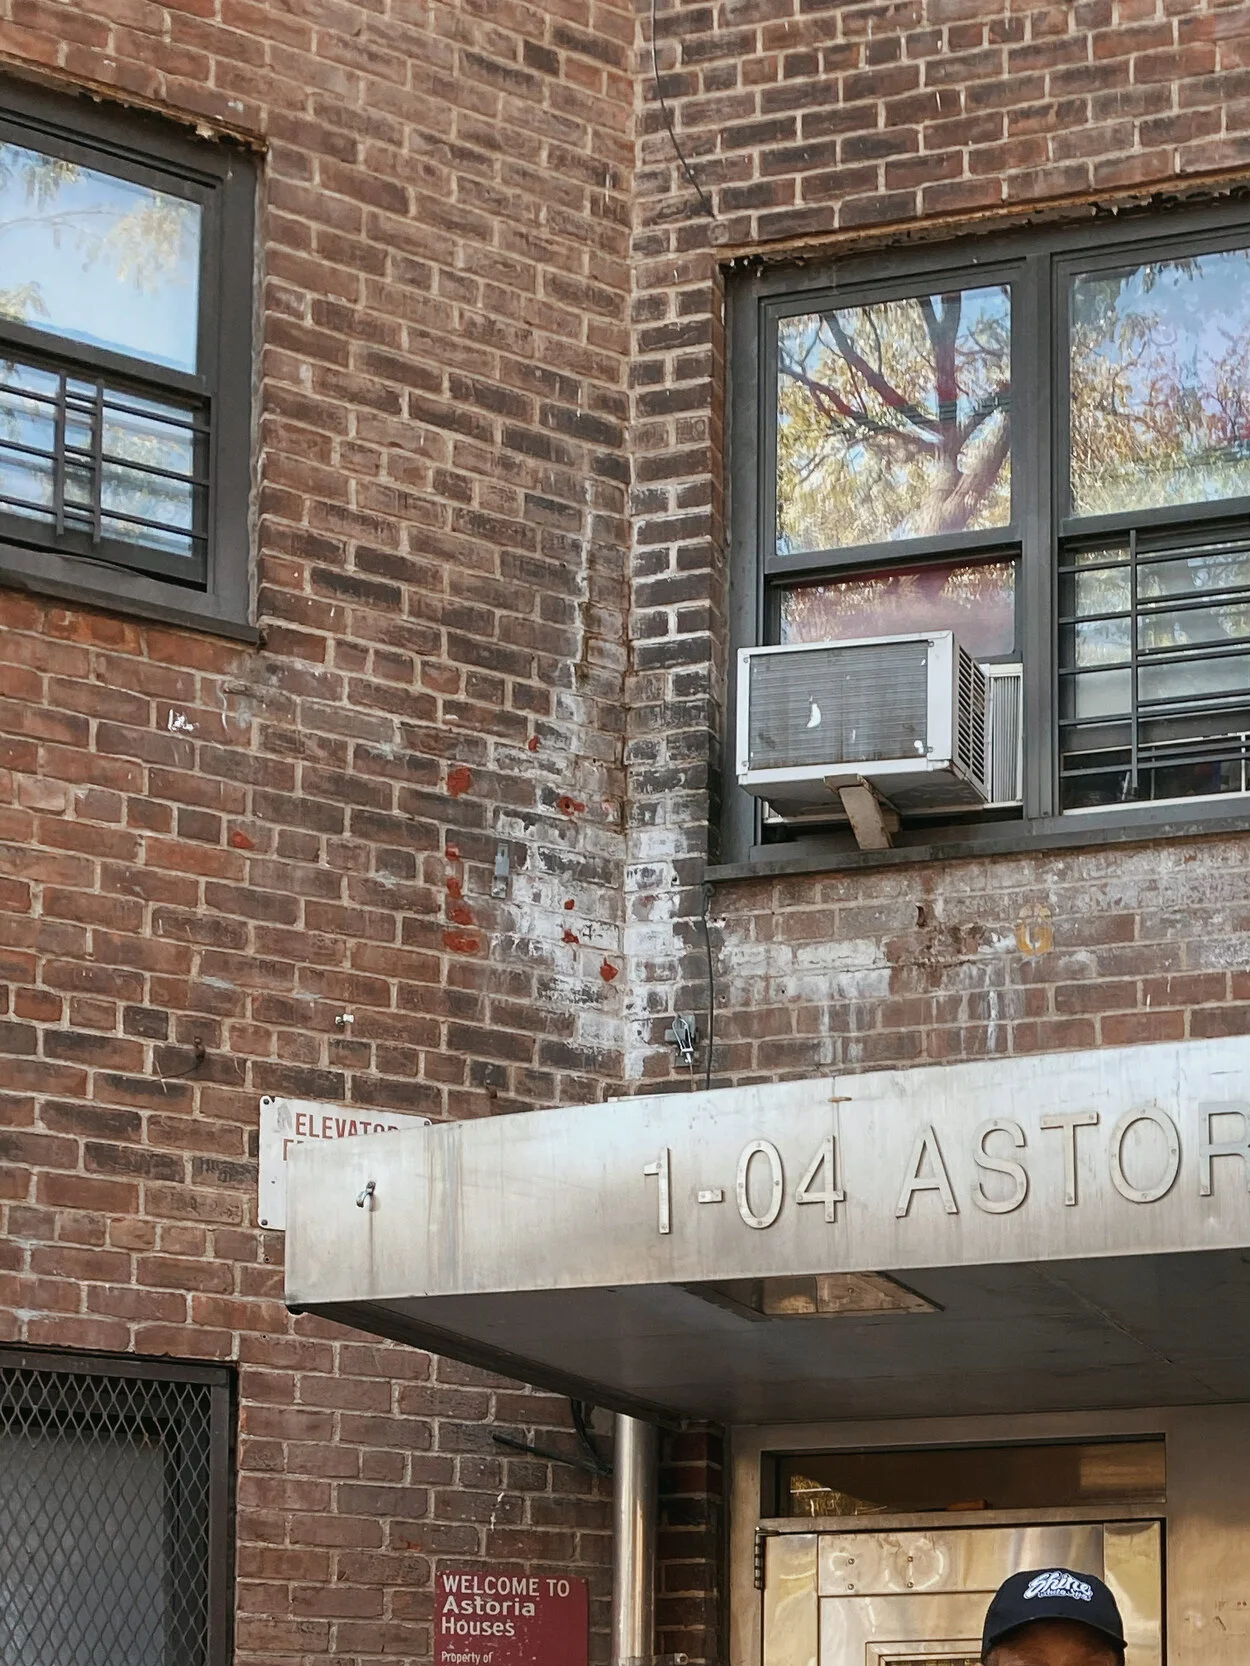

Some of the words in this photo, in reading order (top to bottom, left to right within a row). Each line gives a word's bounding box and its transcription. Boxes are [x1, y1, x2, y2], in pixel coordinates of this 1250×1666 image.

[295, 1112, 399, 1140] ELEVAT
[642, 1133, 846, 1234] 1-04
[442, 1575, 540, 1596] WELCOME
[546, 1579, 570, 1597] TO
[442, 1596, 536, 1617] Astoria
[441, 1617, 515, 1636] Houses
[441, 1651, 482, 1664] Property
[483, 1651, 494, 1663] of
